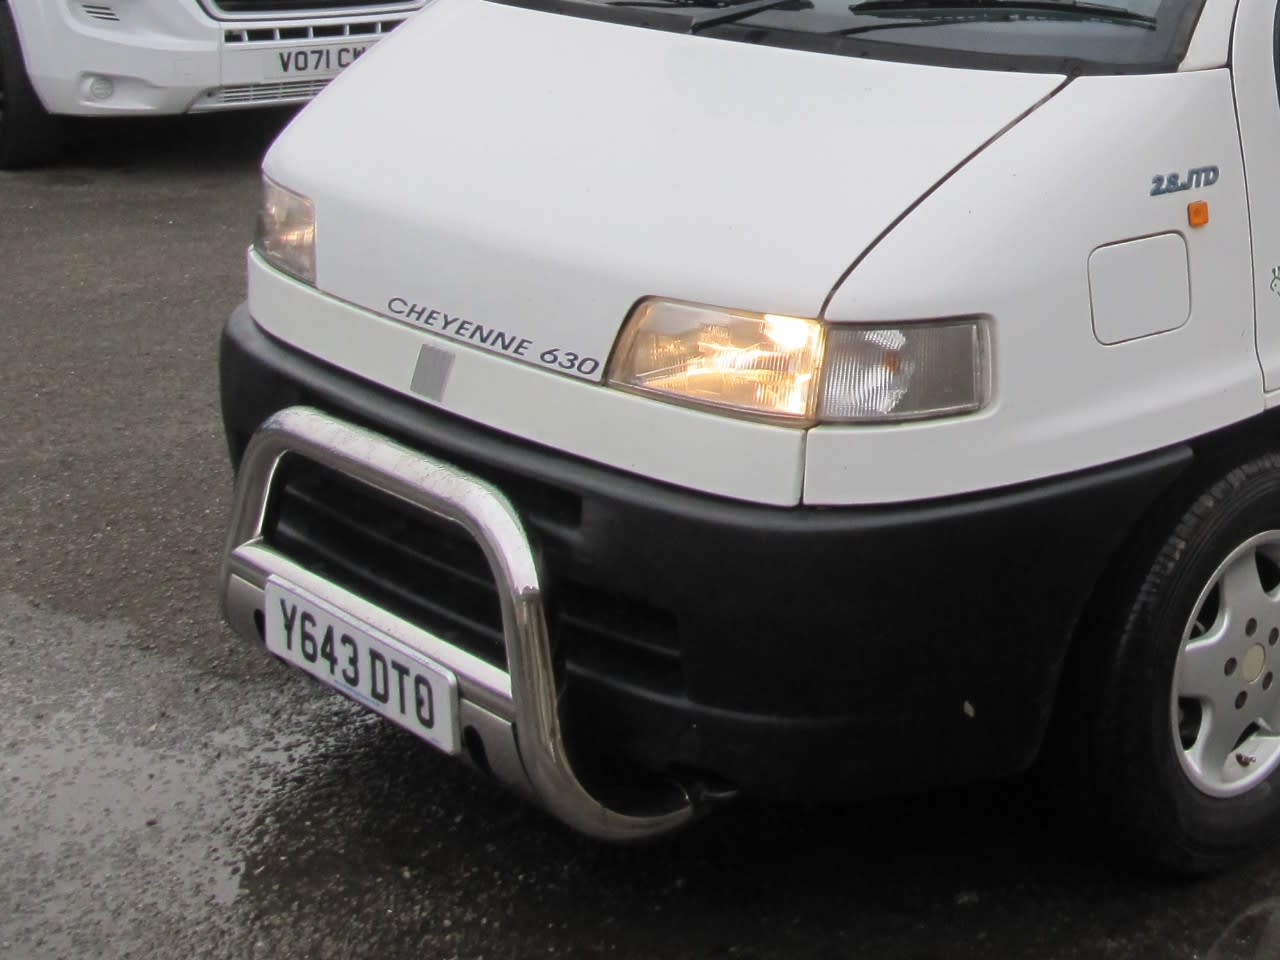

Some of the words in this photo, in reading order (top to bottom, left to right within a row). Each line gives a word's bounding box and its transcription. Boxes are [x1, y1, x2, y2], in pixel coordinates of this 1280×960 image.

[279, 49, 331, 73] VO71
[387, 296, 534, 357] CHEYENNE
[539, 347, 600, 376] 630
[279, 597, 360, 688] Y643
